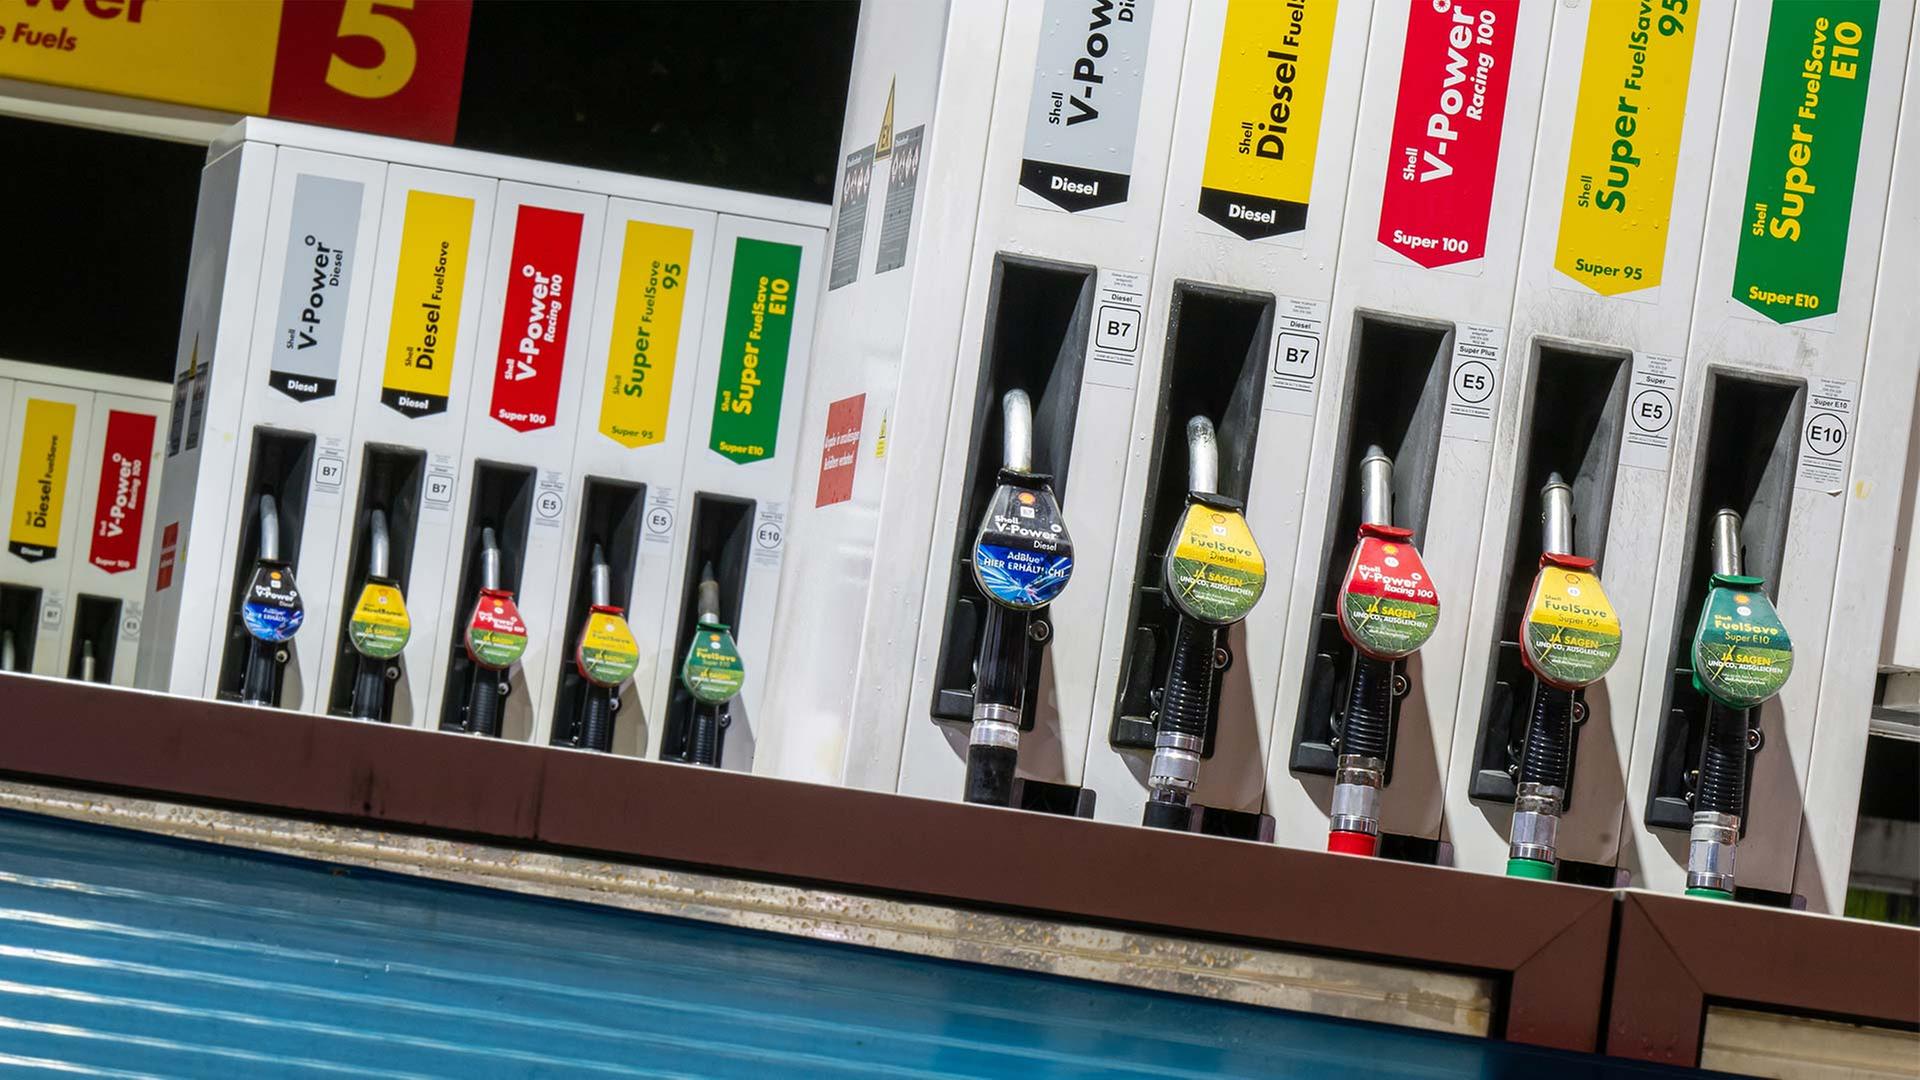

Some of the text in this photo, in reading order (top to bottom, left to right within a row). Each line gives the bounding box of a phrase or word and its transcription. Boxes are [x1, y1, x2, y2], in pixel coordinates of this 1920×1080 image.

[1117, 0, 1136, 23] Di
[1658, 0, 1689, 36] 95
[12, 22, 78, 52] Fuels
[325, 0, 417, 99] 5
[1829, 21, 1863, 80] E10
[1466, 9, 1496, 121] Racing 100
[1255, 0, 1305, 161] Diesel Fuel
[1420, 5, 1475, 183] V-Power
[1049, 91, 1063, 125] Shell
[1595, 0, 1652, 214] Super FuelSav
[1238, 121, 1254, 155] Shell
[1770, 17, 1830, 242] Super FuelSave
[1403, 147, 1418, 181] Shell
[1051, 176, 1098, 196] Diesel
[1578, 175, 1593, 208] Shell
[1228, 204, 1276, 224] Diesel
[1752, 203, 1768, 237] Shell
[1393, 229, 1469, 254] Super 100
[329, 249, 343, 287] Diesel
[663, 263, 681, 290] 95
[1575, 258, 1643, 280] Super 95
[297, 242, 330, 350] V-Power
[416, 241, 449, 370] Diesel FuelSave
[769, 279, 790, 316] E10
[1111, 293, 1133, 303] Diesel
[1749, 286, 1819, 309] Super E10
[544, 275, 563, 343] Racing 100
[515, 271, 549, 381] V-Power
[624, 261, 661, 398] Super FuelSave
[1107, 321, 1131, 337] B7
[1290, 320, 1312, 330] Diesel
[286, 329, 295, 350] Shell
[732, 276, 769, 415] Super FuelSave
[405, 347, 413, 367] Shell
[1286, 348, 1310, 364] B7
[1459, 345, 1496, 357] Super Plus
[504, 359, 514, 380] Shell
[288, 379, 318, 393] Diesel
[1463, 374, 1485, 390] E5
[1645, 376, 1666, 385] Super
[398, 397, 429, 410] Diesel
[1641, 403, 1663, 419] E5
[1814, 398, 1848, 409] Super E10
[498, 409, 546, 424] Super 100
[611, 426, 653, 439] Super 95
[1810, 425, 1842, 444] E10
[719, 441, 764, 456] Super E10
[322, 466, 337, 477] B7
[107, 458, 132, 537] V-Power
[432, 483, 447, 494] B7
[33, 479, 52, 528] Diesel
[542, 499, 557, 511] E5
[652, 515, 667, 526] E5
[995, 515, 1019, 524] Shell
[759, 530, 780, 541] E10
[995, 522, 1057, 540] V-Power
[1033, 540, 1057, 551] Diesel
[1190, 536, 1252, 557] FuelSave
[983, 557, 1005, 569] HIER
[1208, 571, 1243, 587] SAGEN
[1360, 571, 1418, 588] V-Power
[1384, 585, 1434, 598] Racing 100
[1366, 604, 1417, 619] JA SAGEN
[1545, 600, 1607, 618] FuelSave
[1558, 614, 1584, 625] Super
[1714, 620, 1778, 636] FuelSave
[1549, 633, 1599, 649] JA SAGEN
[1725, 631, 1770, 645] Super E10
[1721, 652, 1771, 666] JA SAGEN
